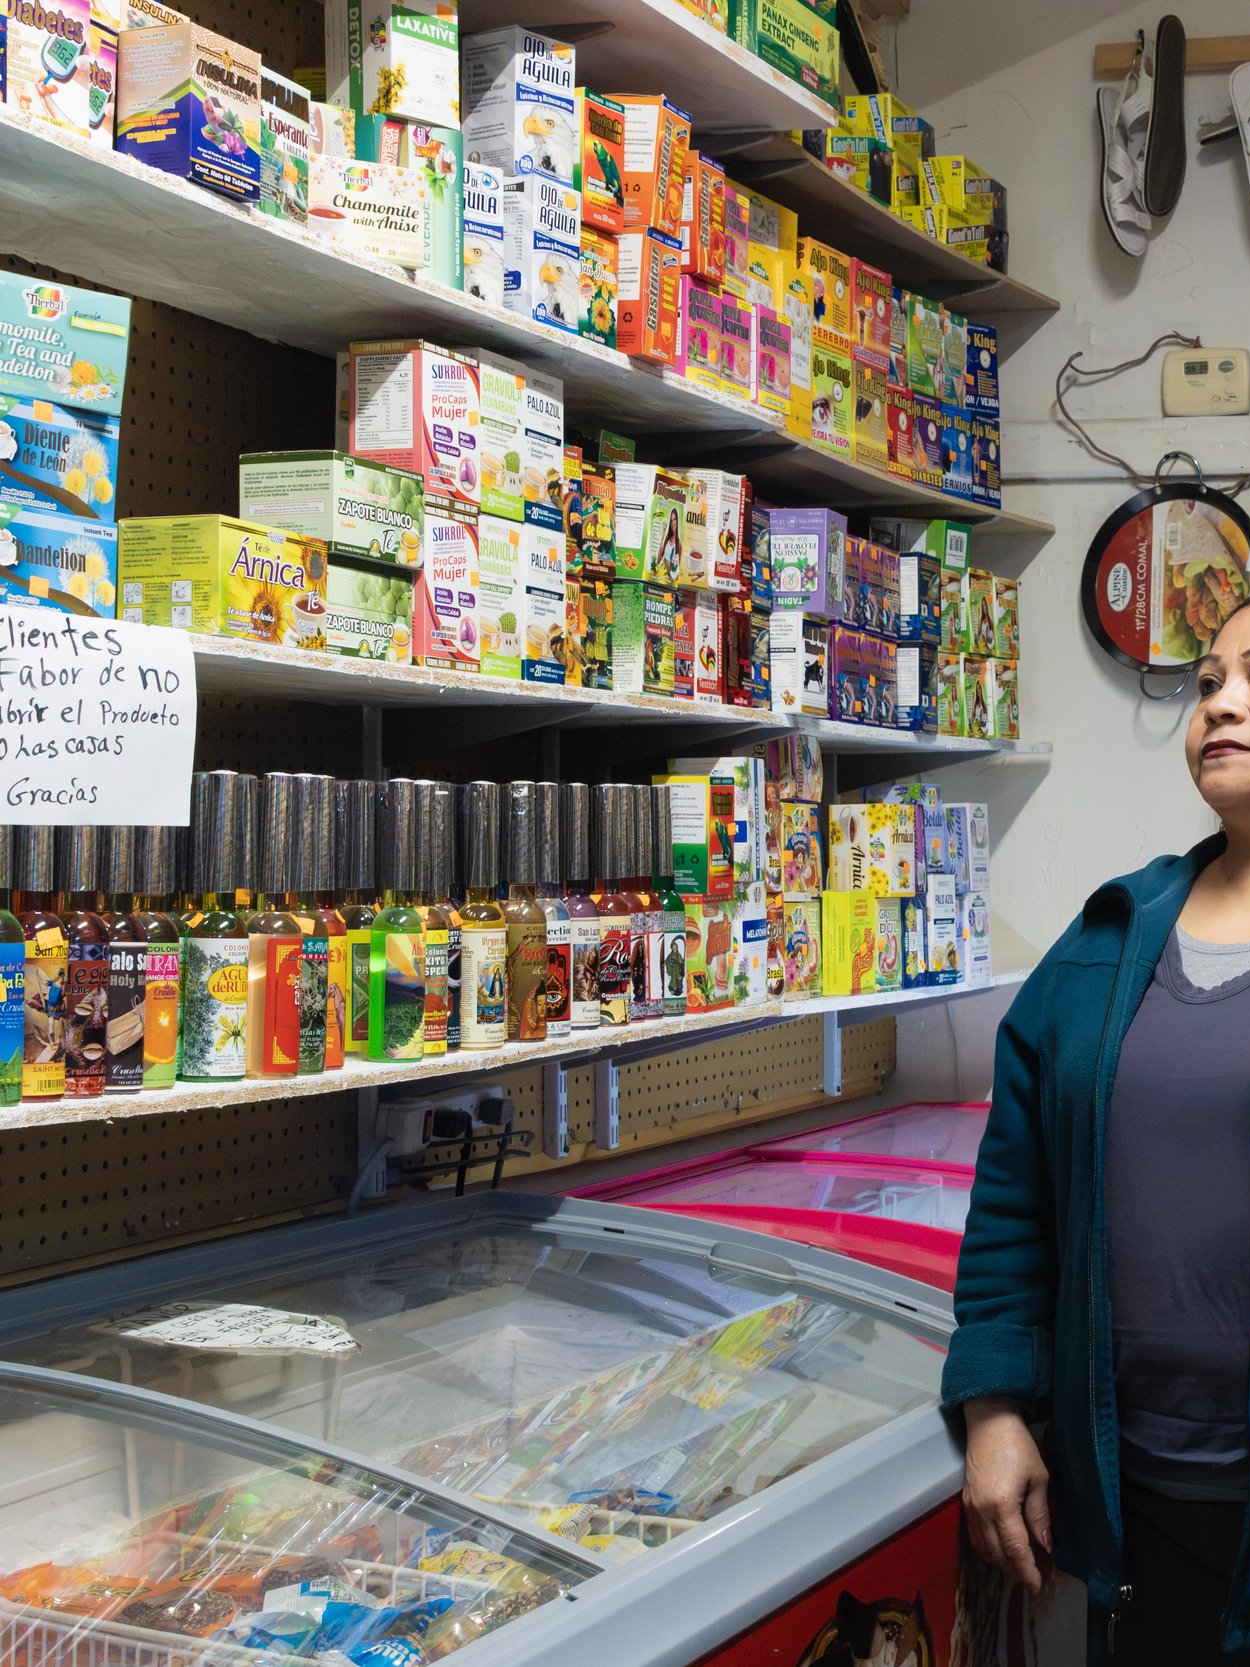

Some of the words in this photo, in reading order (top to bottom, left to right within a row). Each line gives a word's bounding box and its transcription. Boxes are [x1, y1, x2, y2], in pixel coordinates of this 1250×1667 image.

[348, 6, 360, 72] DETOX
[396, 15, 456, 46] LAXATIVE
[761, 20, 796, 50] EXTRACT
[762, 3, 788, 28] PANAX
[789, 22, 820, 52] GINSENG
[522, 34, 546, 62] OJO
[196, 58, 259, 100] INSULINA
[522, 58, 571, 89] AGUILA
[332, 193, 420, 219] Chamomile
[540, 184, 557, 206] OJO
[353, 216, 375, 228] with
[376, 218, 420, 234] Anise
[540, 205, 576, 236] AGUILA
[810, 248, 827, 273] Ajo
[829, 255, 850, 286] King
[855, 268, 871, 289] Ajo
[871, 275, 892, 303] King
[26, 290, 66, 313] Therbal
[8, 339, 38, 362] Tea
[39, 345, 75, 368] and
[973, 331, 997, 354] King
[431, 394, 468, 408] ProCaps
[432, 404, 468, 421] Mujer
[527, 395, 544, 412] PALO
[545, 401, 561, 420] AZUL
[23, 422, 71, 455] Diente
[21, 447, 37, 467] de
[39, 450, 67, 473] León
[944, 478, 972, 494] ERVIOS
[338, 498, 376, 522] ZAPOTE
[376, 506, 413, 530] BLANCO
[84, 525, 100, 536] Instant
[101, 529, 113, 539] Tea
[382, 529, 396, 554] Té
[15, 538, 88, 574] Dandelion
[230, 536, 306, 589] Árnica
[433, 556, 467, 568] ProCaps
[531, 552, 547, 568] PALO
[774, 548, 808, 557] PASSION
[1136, 540, 1148, 581] COMAL
[433, 567, 467, 583] Mujer
[1110, 566, 1121, 607] ALPINE
[305, 590, 320, 611] Té
[645, 600, 673, 614] ROMPE
[326, 613, 360, 632] ZAPOTE
[361, 619, 394, 639] BLANCO
[644, 611, 674, 629] PIEDRAS
[100, 658, 125, 686] de
[138, 665, 180, 694] no
[60, 698, 83, 725] el
[110, 974, 135, 988] Holy
